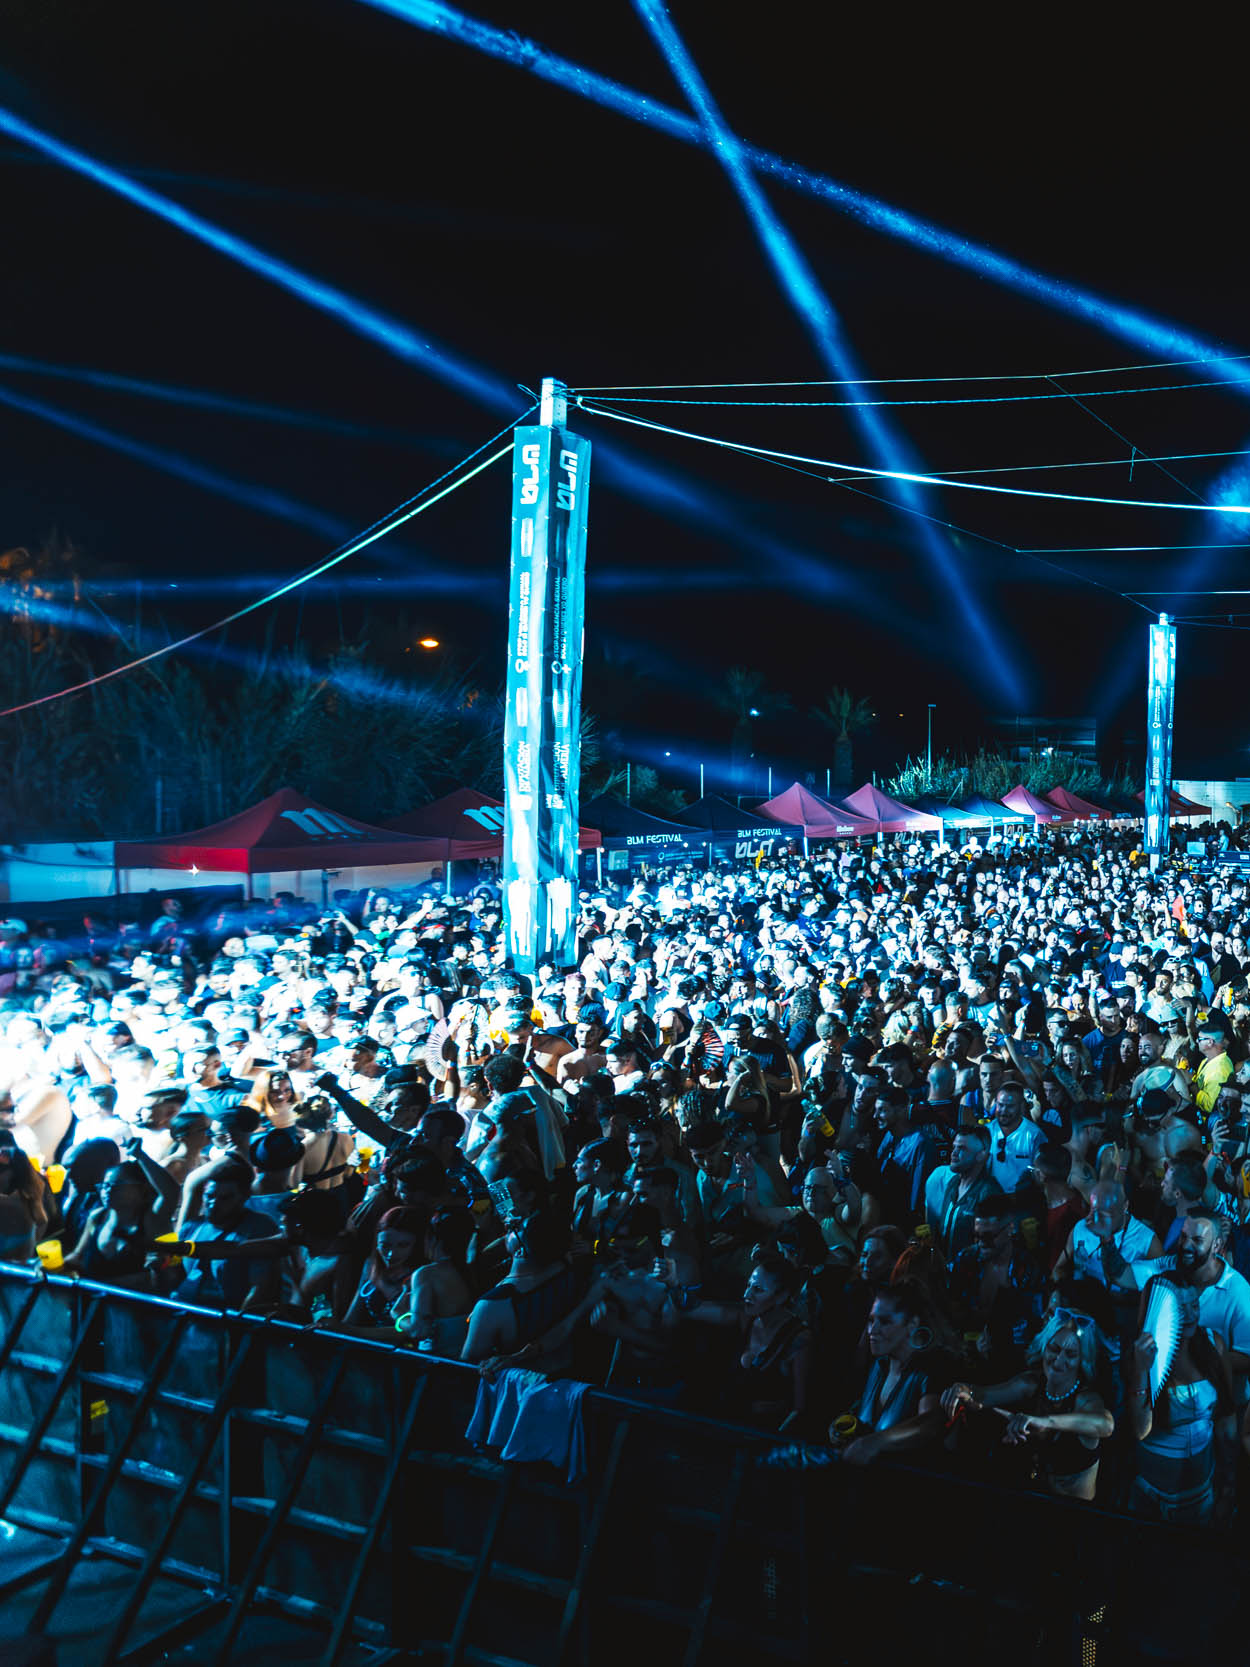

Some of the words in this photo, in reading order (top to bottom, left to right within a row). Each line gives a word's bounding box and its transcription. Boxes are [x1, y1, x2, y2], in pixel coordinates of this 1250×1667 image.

[737, 829, 752, 838] BLM
[752, 828, 782, 837] FESTIVAL
[627, 835, 644, 845] BLM
[646, 833, 682, 844] FESTIVAL
